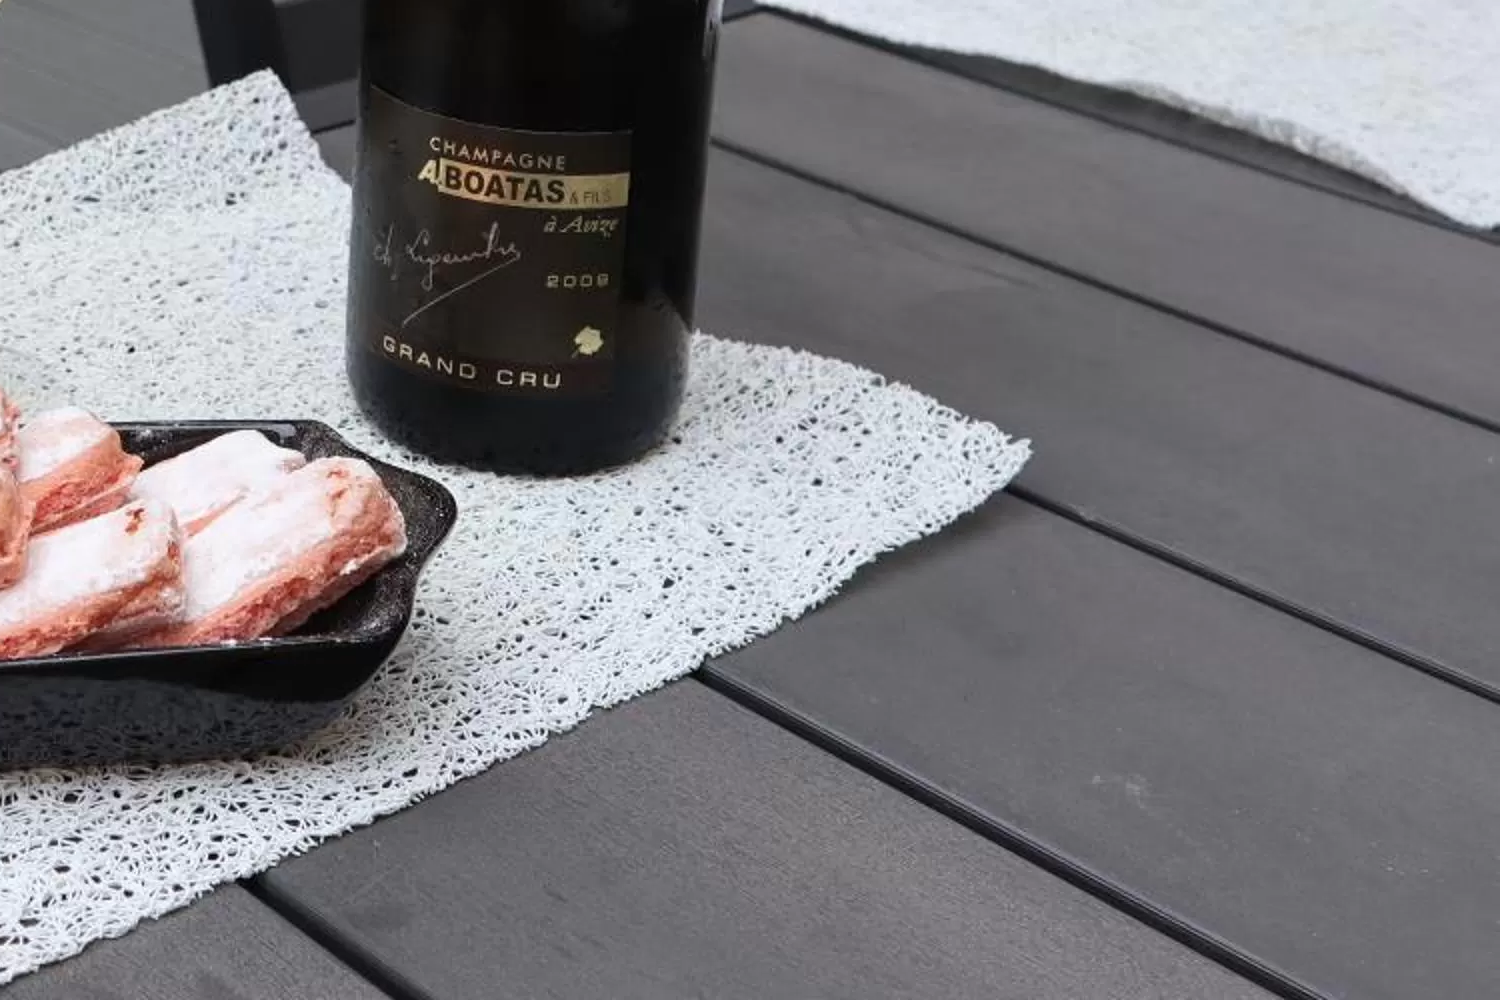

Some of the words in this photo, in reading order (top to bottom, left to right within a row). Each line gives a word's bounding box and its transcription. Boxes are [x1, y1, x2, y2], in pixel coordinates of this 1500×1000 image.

[429, 136, 566, 171] CHAMPAGNE
[382, 335, 477, 380] GRAND
[496, 369, 563, 389] CRU
